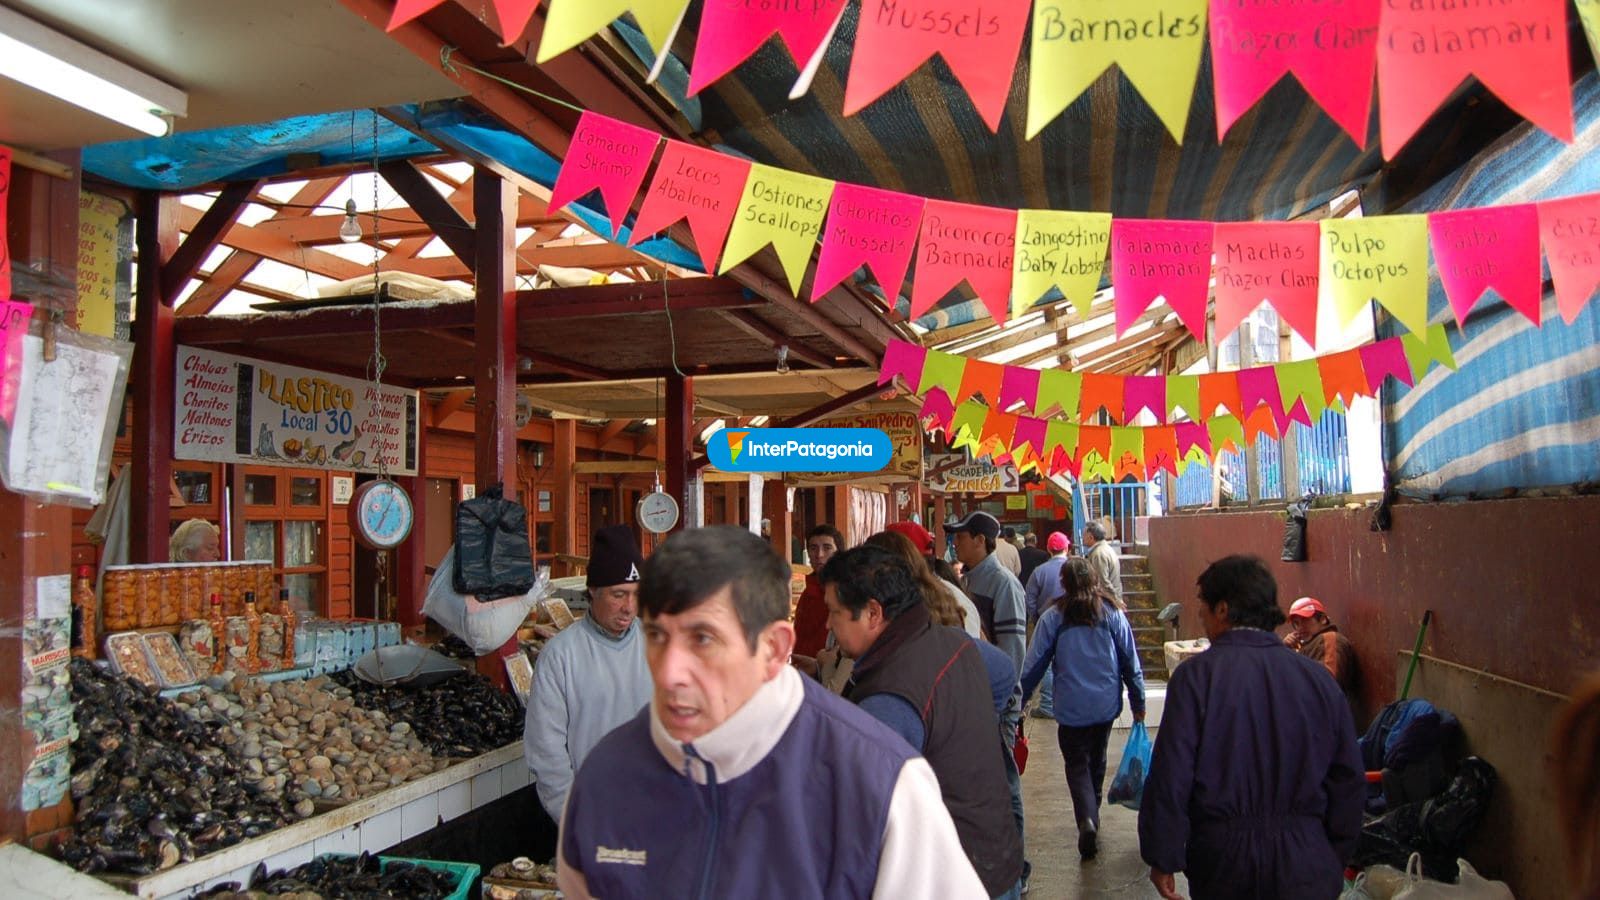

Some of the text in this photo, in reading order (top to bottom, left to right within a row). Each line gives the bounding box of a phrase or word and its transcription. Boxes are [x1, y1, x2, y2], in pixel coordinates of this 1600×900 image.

[878, 0, 1000, 36] Mussels
[1041, 7, 1200, 42] Barnacles
[676, 157, 721, 186] Locos
[752, 180, 824, 213] Ostiones
[745, 204, 819, 238] Scallops
[929, 215, 1015, 248] Picorocos
[1021, 223, 1108, 257] Langostino
[1327, 230, 1386, 257] Pulpo
[1018, 249, 1058, 277] Baby
[1332, 260, 1408, 284] Octopus
[184, 373, 236, 394] Almejas
[183, 391, 230, 411] Choritos
[180, 409, 233, 428] Maltones
[280, 408, 353, 436] Local 30
[180, 427, 225, 445] Erizos
[625, 561, 641, 581] A
